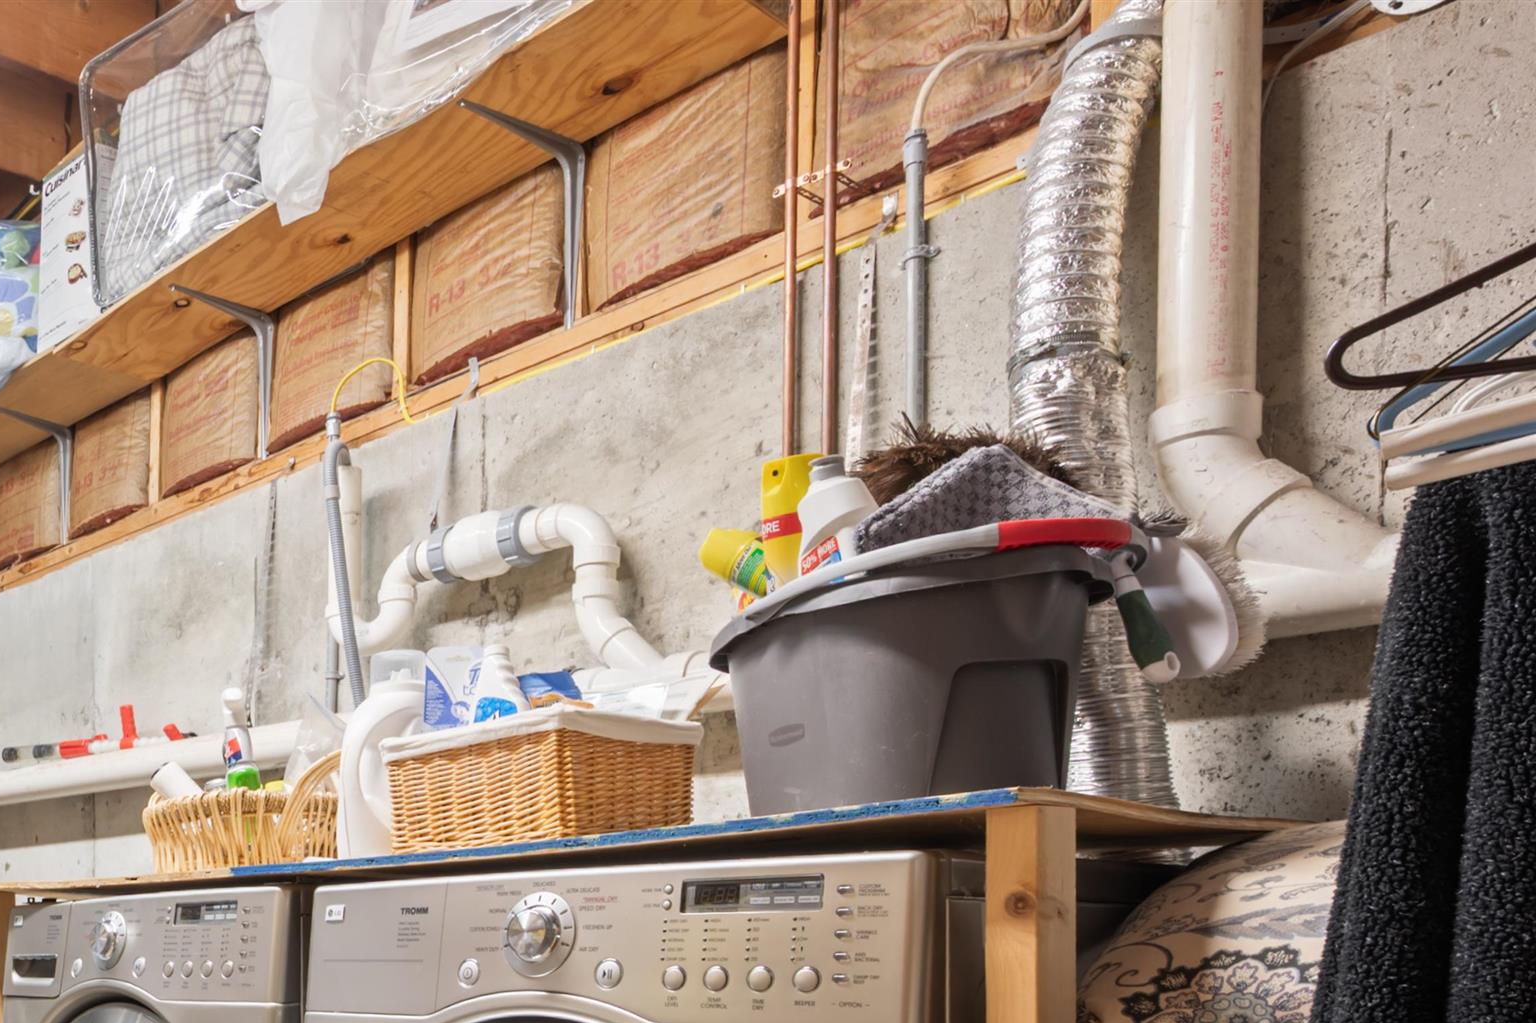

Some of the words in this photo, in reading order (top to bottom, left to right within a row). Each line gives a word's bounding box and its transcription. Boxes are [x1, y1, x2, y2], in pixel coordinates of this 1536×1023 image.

[45, 158, 86, 198] Cuisinar
[802, 551, 817, 571] 50%
[817, 538, 837, 557] MORE
[400, 907, 429, 916] TROMM
